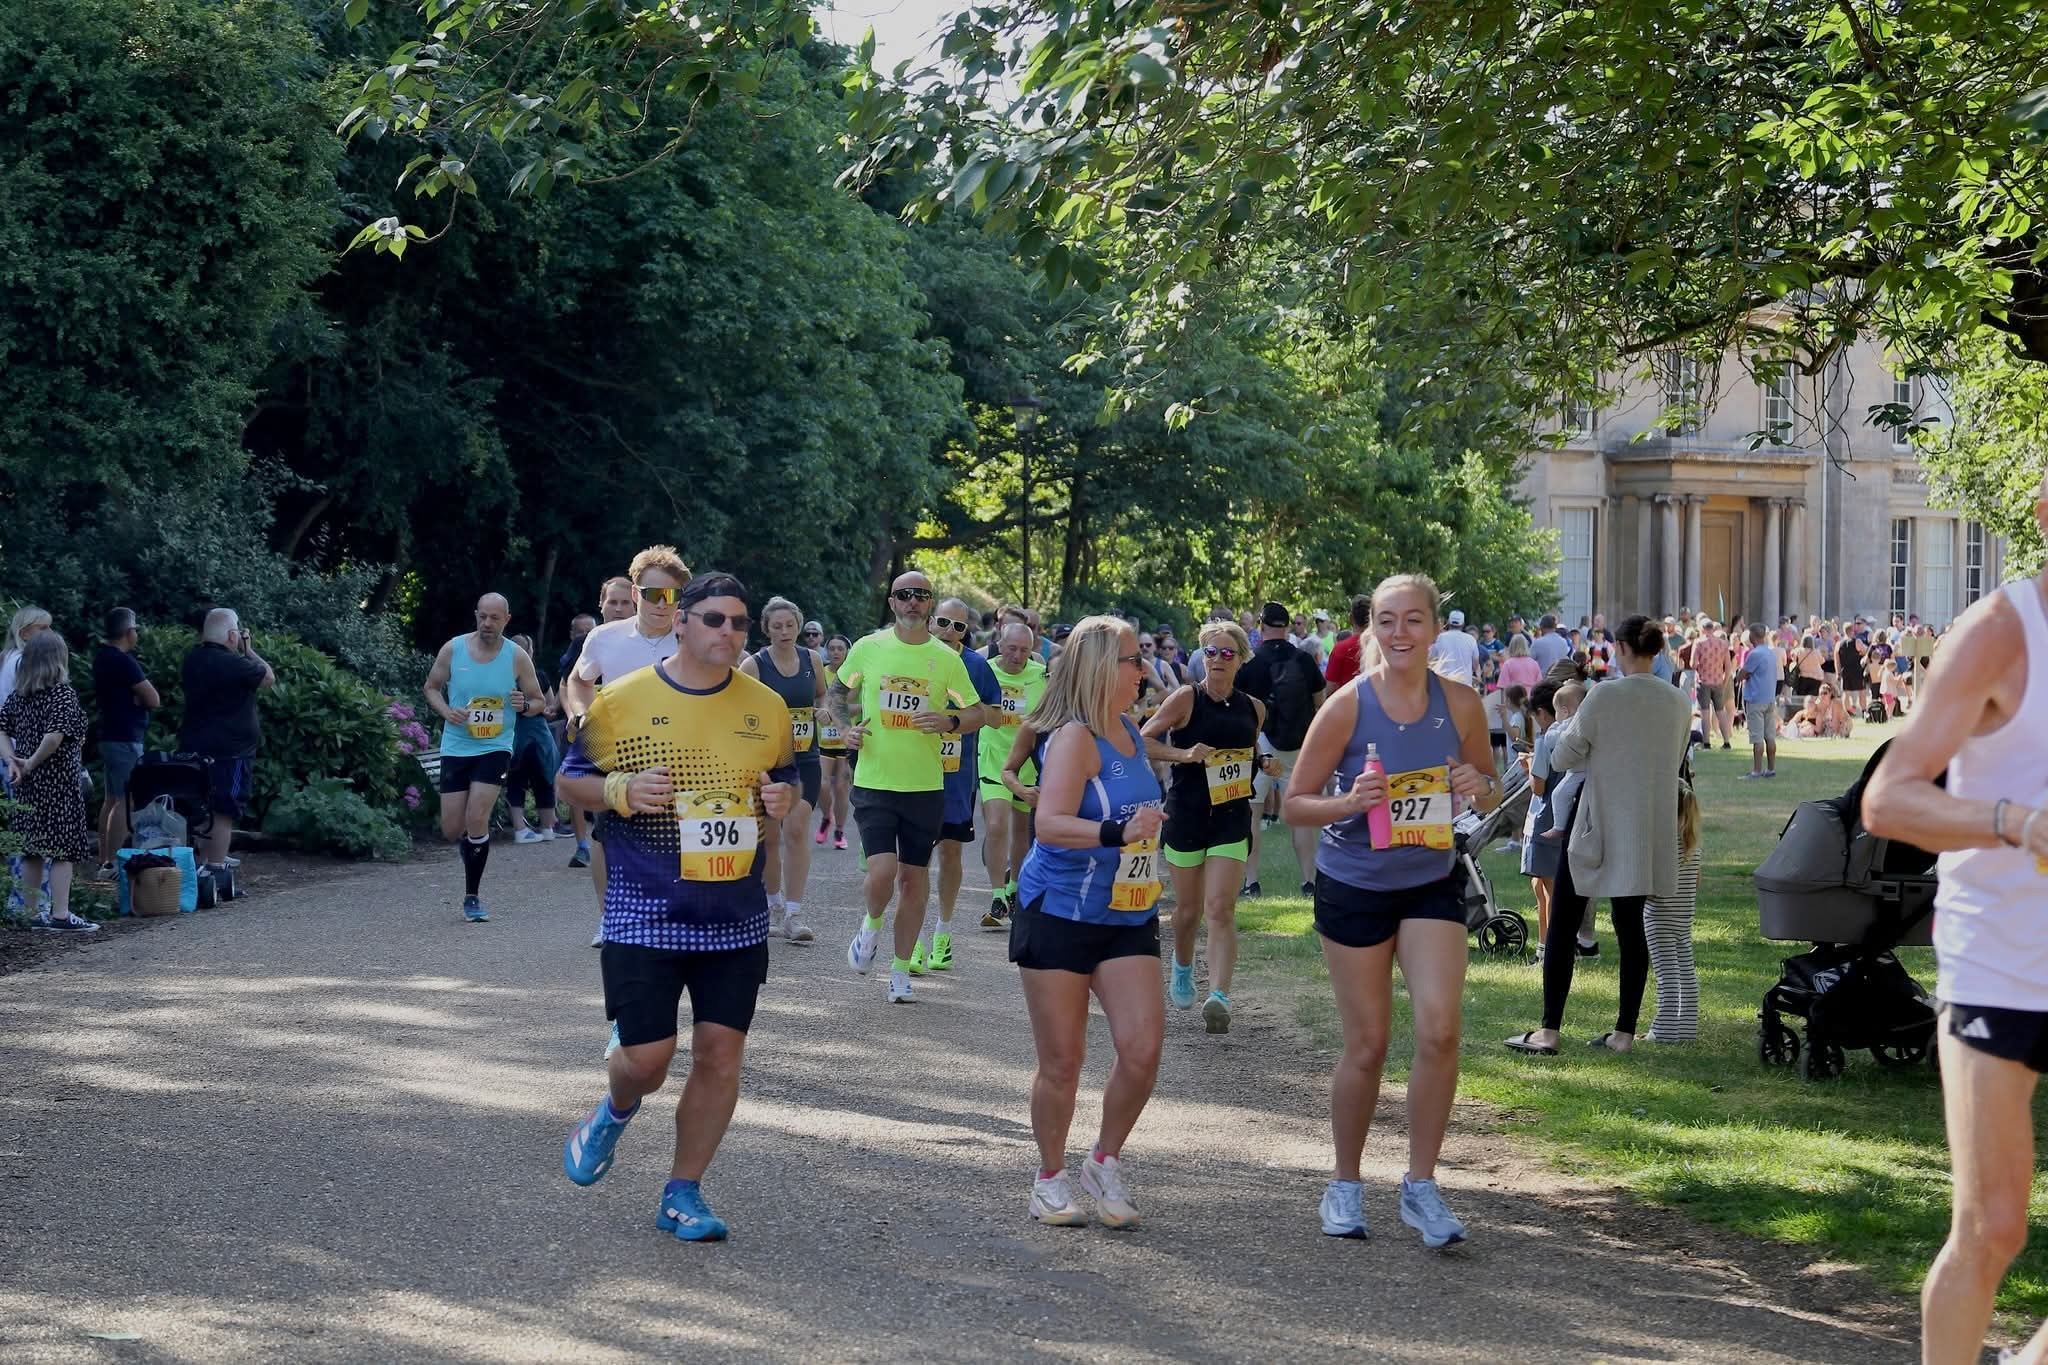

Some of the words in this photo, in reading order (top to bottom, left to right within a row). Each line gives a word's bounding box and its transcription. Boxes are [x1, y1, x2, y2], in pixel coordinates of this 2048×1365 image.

[888, 693, 920, 711] 1159
[1002, 699, 1016, 711] 98
[474, 711, 494, 722] 516
[651, 716, 670, 725] DC
[892, 715, 909, 728] 10K
[477, 726, 491, 736] 10K
[827, 728, 840, 737] 33
[941, 742, 954, 755] 22
[1219, 763, 1240, 781] 499
[1225, 784, 1239, 800] 10K
[1391, 798, 1431, 821] 927
[700, 820, 739, 846] 396
[1398, 830, 1425, 846] 10K
[708, 856, 735, 877] 10K
[1128, 856, 1151, 878] 276
[1130, 888, 1149, 907] 10K
